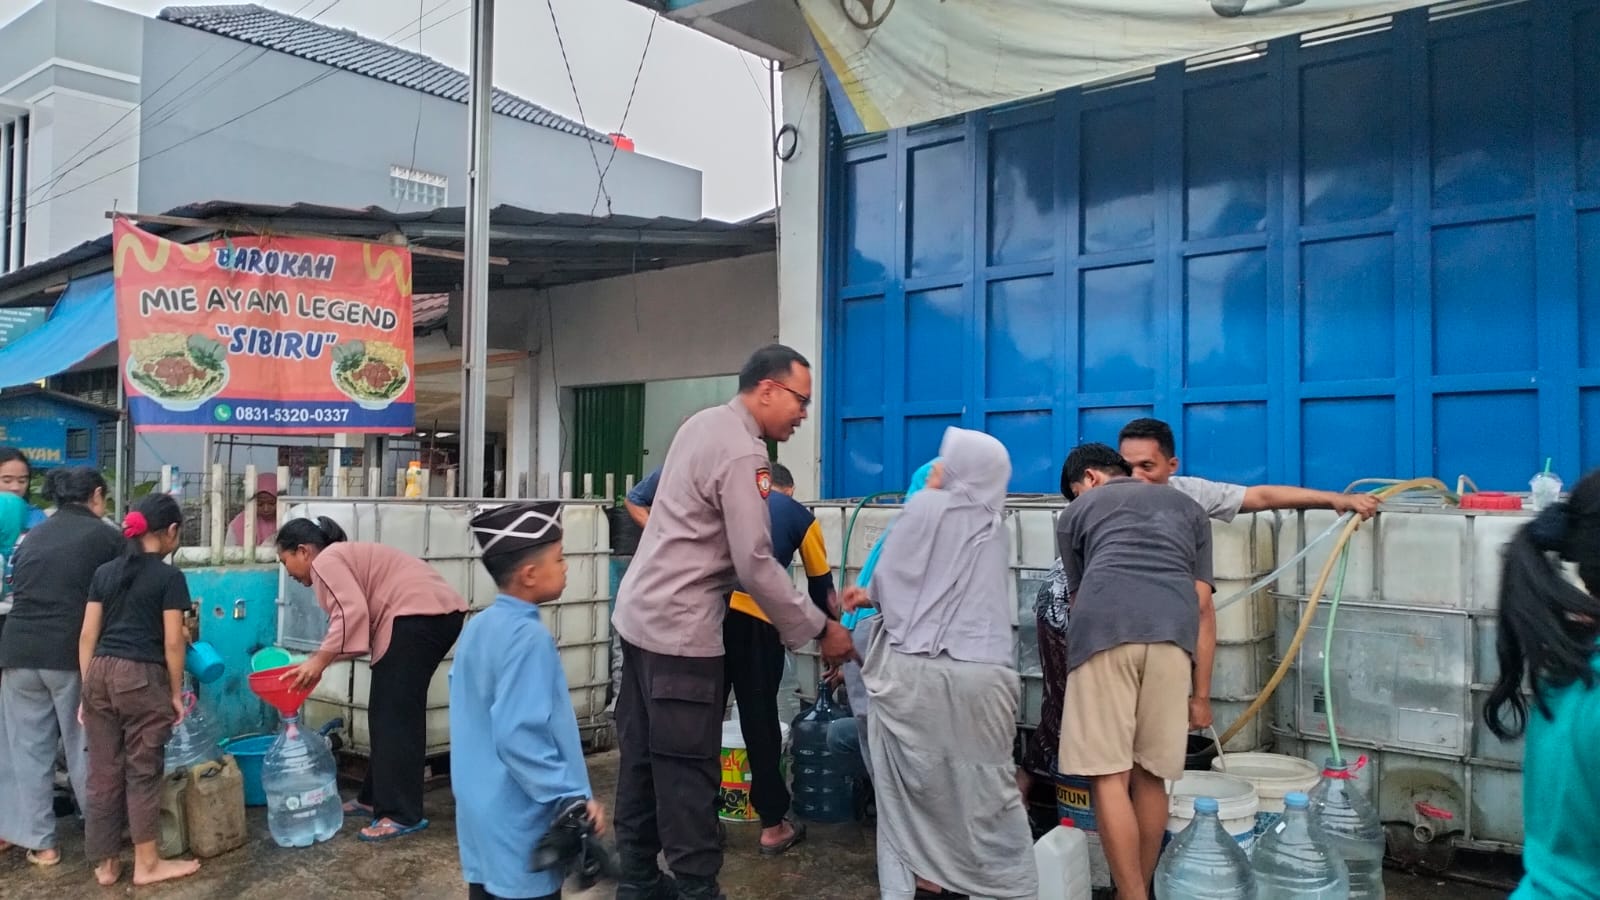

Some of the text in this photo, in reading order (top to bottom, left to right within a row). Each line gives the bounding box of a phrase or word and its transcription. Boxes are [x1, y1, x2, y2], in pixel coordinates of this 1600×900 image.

[215, 247, 334, 280] BAROKAH
[141, 287, 397, 331] MIE AYAM LEGEND
[216, 325, 337, 359] "SIBIRU"
[235, 406, 350, 422] 0831-5320-0337
